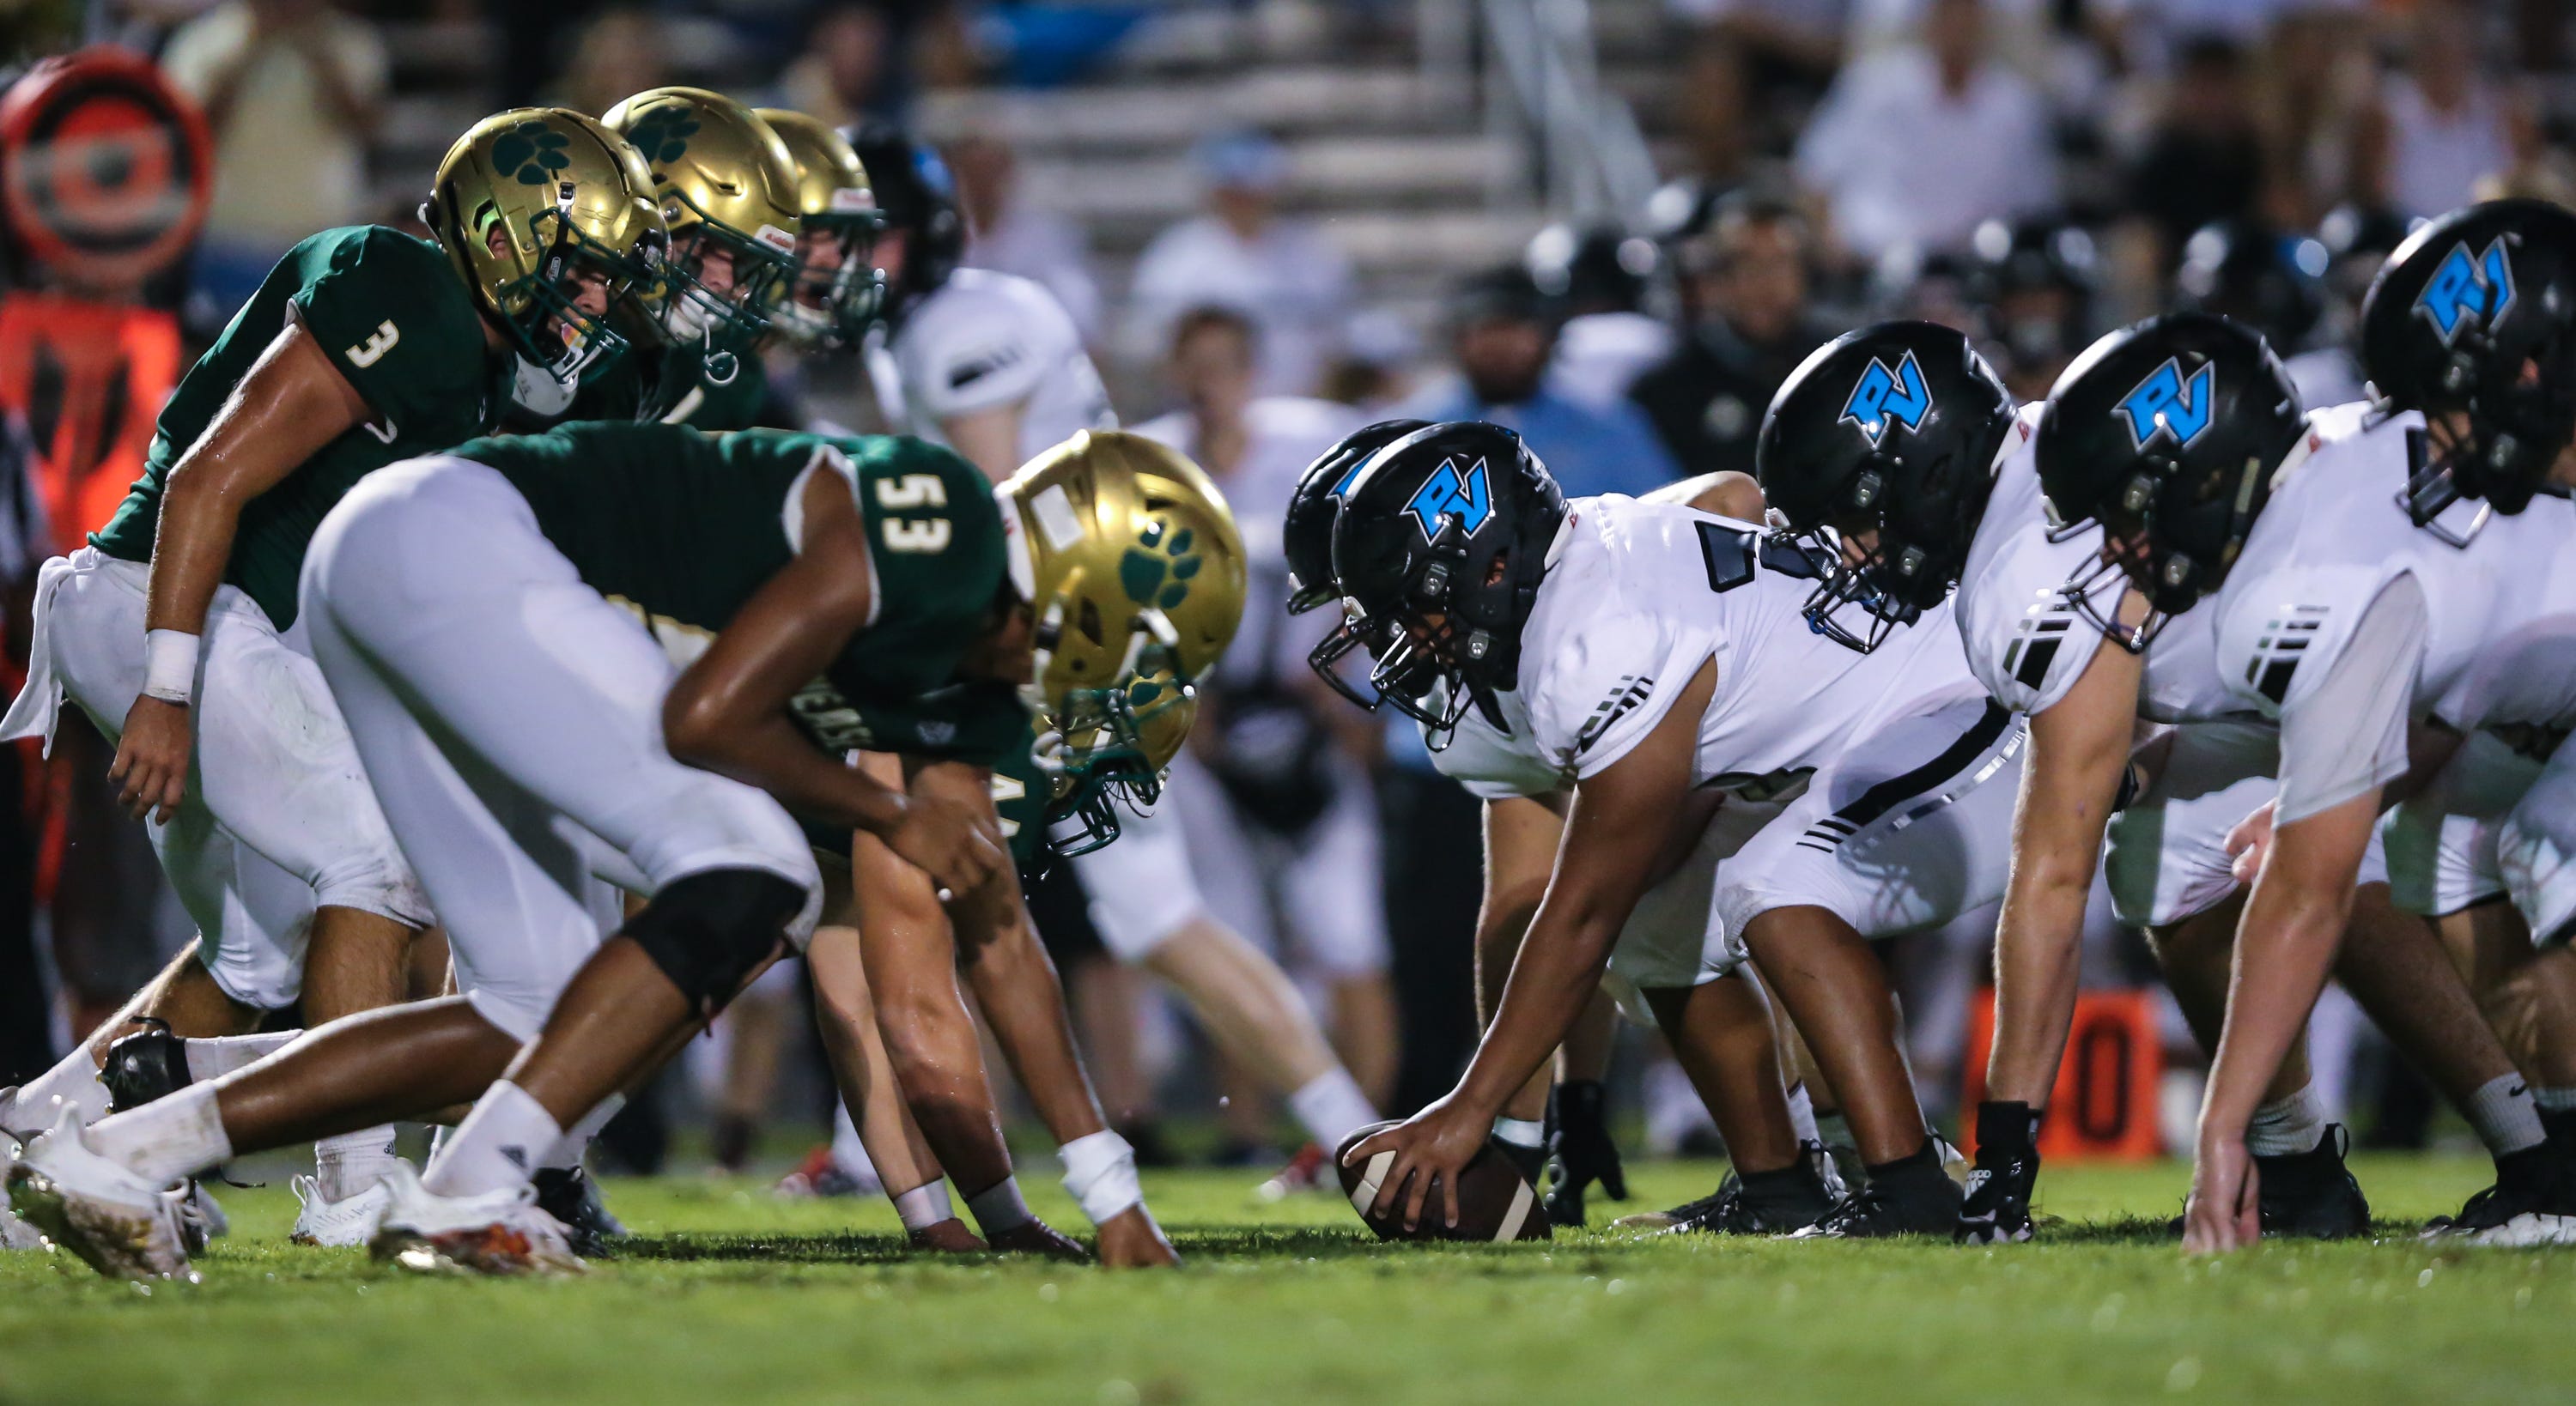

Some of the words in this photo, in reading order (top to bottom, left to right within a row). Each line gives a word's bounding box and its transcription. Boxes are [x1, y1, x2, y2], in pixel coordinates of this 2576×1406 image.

[345, 318, 399, 367] 3
[1838, 348, 1933, 450] PV
[2110, 356, 2215, 454] PV
[875, 473, 951, 555] 53
[1399, 456, 1493, 547] PV
